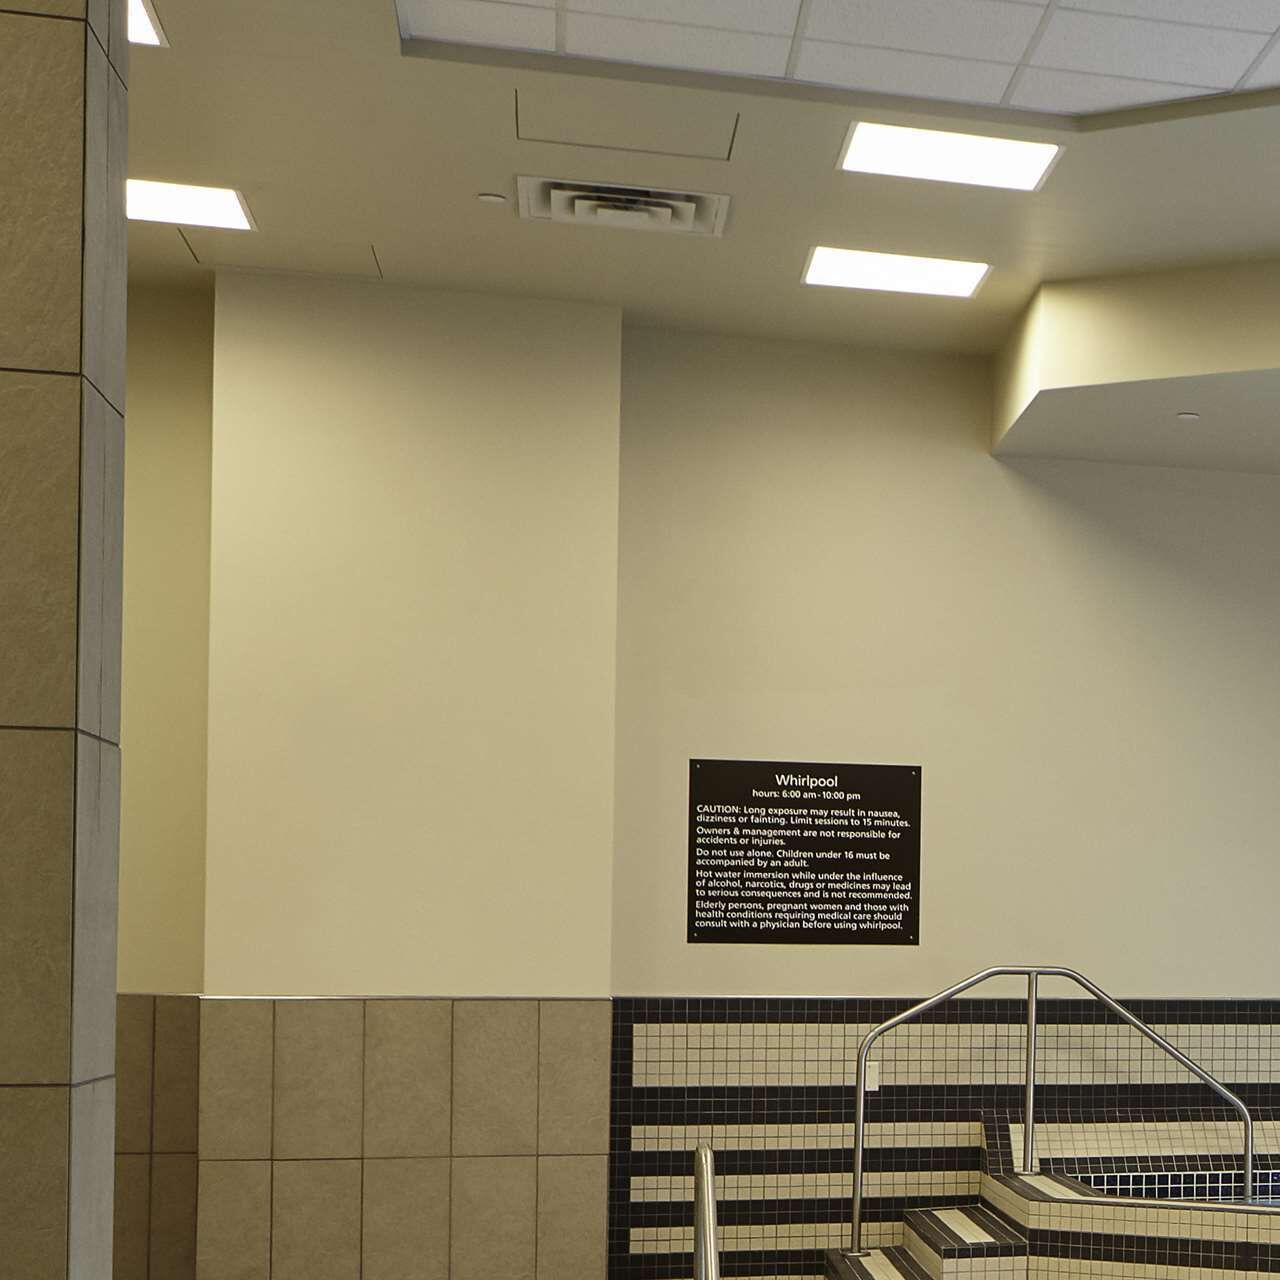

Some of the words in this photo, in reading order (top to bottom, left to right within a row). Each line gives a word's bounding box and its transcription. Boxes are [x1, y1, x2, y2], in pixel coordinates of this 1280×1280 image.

[775, 774, 838, 788] Whirlpool
[752, 788, 780, 798] hours:
[781, 789, 801, 798] 6:00
[846, 793, 860, 801] pm
[696, 804, 741, 816] CAUTION:
[743, 805, 766, 816] Long
[767, 807, 808, 818] exposure
[809, 808, 828, 818] may
[830, 807, 855, 819] result
[857, 808, 866, 819] in
[866, 810, 900, 820] nausea,
[696, 813, 736, 823] dizziness
[749, 814, 788, 826] fainting.
[790, 815, 812, 825] Limit
[814, 816, 848, 825] sessions
[849, 817, 860, 826] to
[862, 817, 872, 826] 15
[873, 818, 911, 827] minutes.
[696, 826, 731, 836] Owners
[732, 826, 740, 835] &
[741, 827, 801, 838] management
[802, 829, 817, 837] are
[819, 829, 835, 838] not
[836, 829, 886, 840] responsible
[887, 830, 901, 839] for
[695, 835, 737, 844] accidents
[751, 836, 786, 847] injuries.
[695, 847, 709, 856] Do
[711, 848, 727, 856] not
[729, 849, 744, 857] use
[746, 848, 774, 857] alone.
[776, 849, 813, 858] Children
[815, 849, 842, 859] under
[844, 850, 854, 859] 16
[855, 851, 877, 860] must
[878, 851, 890, 860] be
[695, 856, 755, 867] accompanied
[756, 858, 768, 868] by
[769, 859, 781, 867] an
[783, 858, 809, 867] adult.
[695, 869, 712, 878] Hot
[714, 870, 741, 878] water
[743, 869, 789, 879] immersion
[791, 870, 816, 880] while
[817, 871, 844, 880] under
[845, 871, 861, 880] the
[862, 871, 903, 881] influence
[695, 878, 705, 887] of
[707, 878, 743, 888] alcohol,
[745, 879, 786, 889] narcotics,
[788, 879, 814, 890] drugs
[827, 880, 870, 890] medicines
[872, 883, 891, 892] may
[892, 881, 911, 890] lead
[695, 888, 706, 896] to
[707, 888, 739, 896] serious
[740, 889, 801, 899] consequences
[802, 889, 820, 898] and
[822, 889, 829, 898] is
[830, 890, 846, 898] not
[848, 890, 912, 899] recommended.
[695, 900, 726, 911] Elderly
[727, 902, 764, 912] persons,
[766, 901, 808, 912] pregnant
[809, 903, 842, 913] women
[844, 902, 861, 913] and
[863, 902, 887, 913] those
[888, 903, 909, 913] with
[695, 909, 724, 918] health
[725, 909, 773, 920] conditions
[774, 910, 817, 921] requiring
[817, 911, 851, 921] medical
[852, 913, 871, 921] care
[873, 911, 902, 922] should
[694, 918, 727, 927] consult
[728, 919, 750, 928] with
[759, 919, 800, 930] physician
[802, 919, 832, 928] before
[833, 920, 857, 930] using
[858, 920, 903, 931] whirlpool.
